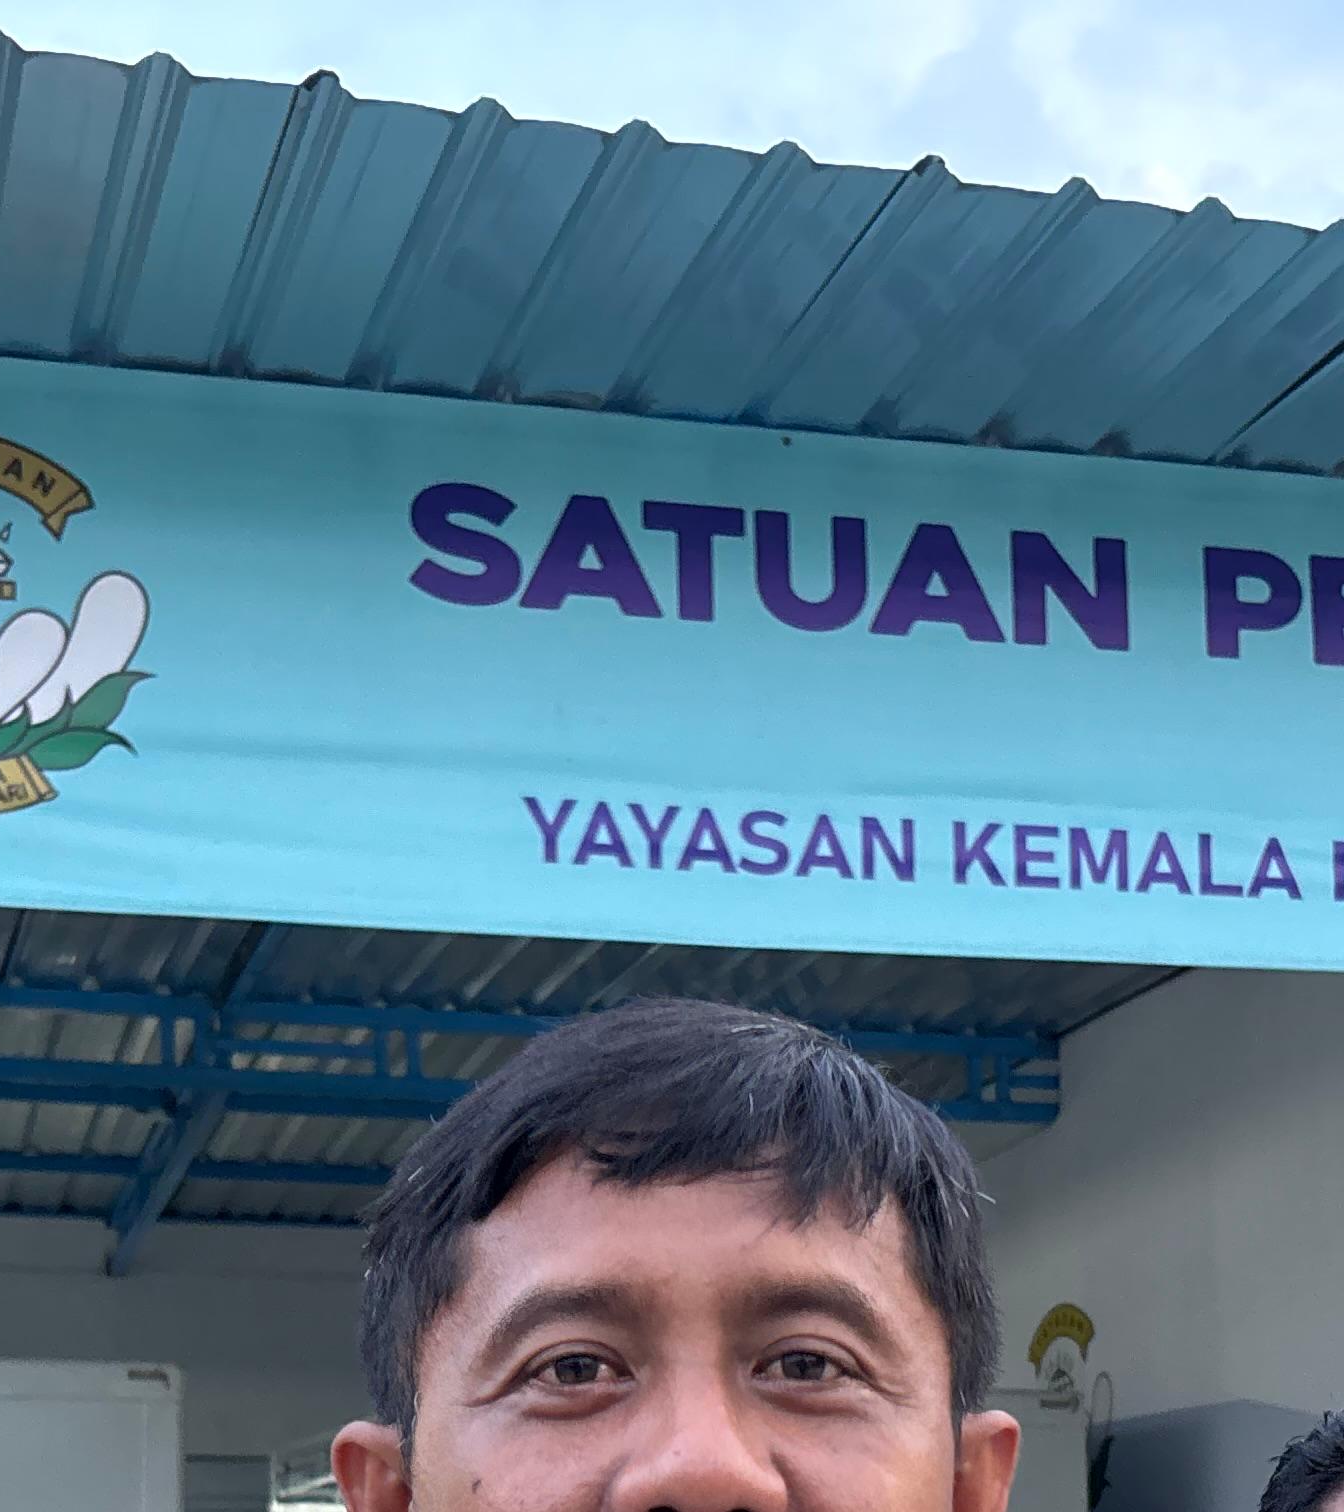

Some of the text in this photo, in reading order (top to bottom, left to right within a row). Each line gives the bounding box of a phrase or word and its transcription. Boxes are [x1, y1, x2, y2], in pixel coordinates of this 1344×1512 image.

[409, 482, 1129, 651] SATUAN
[524, 796, 915, 880] YAYASAN
[954, 821, 1302, 898] KEMALA
